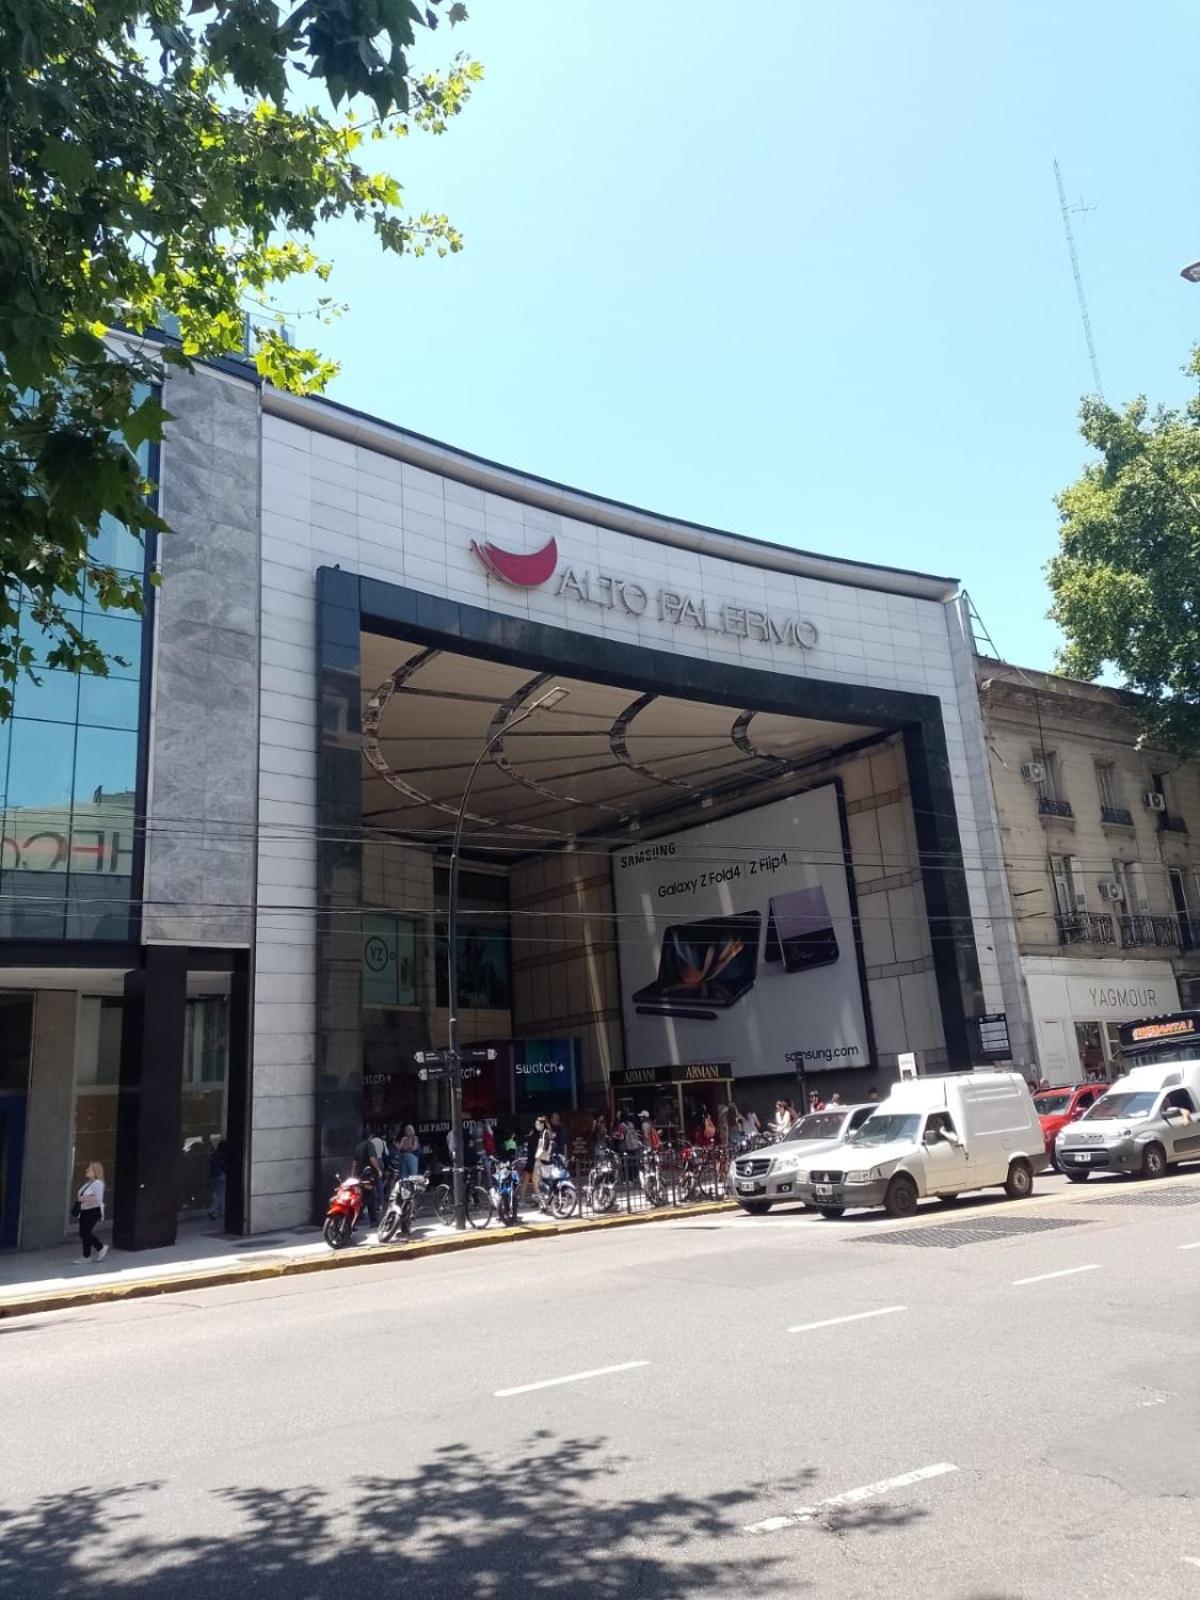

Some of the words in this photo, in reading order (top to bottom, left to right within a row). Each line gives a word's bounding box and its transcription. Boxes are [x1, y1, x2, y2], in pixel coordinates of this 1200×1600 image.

[555, 565, 648, 615] ALTO
[658, 590, 818, 649] PALERMO
[620, 843, 676, 869] SAMSUNG
[658, 877, 697, 898] Galaxy
[700, 873, 708, 887] Z
[709, 865, 741, 885] Fold4
[750, 861, 758, 874] Z
[760, 852, 788, 874] Flip4
[1089, 988, 1158, 1008] YAGMOUR
[515, 1062, 558, 1074] swatch
[624, 1069, 655, 1084] ARMANI
[686, 1065, 719, 1079] ARMANI
